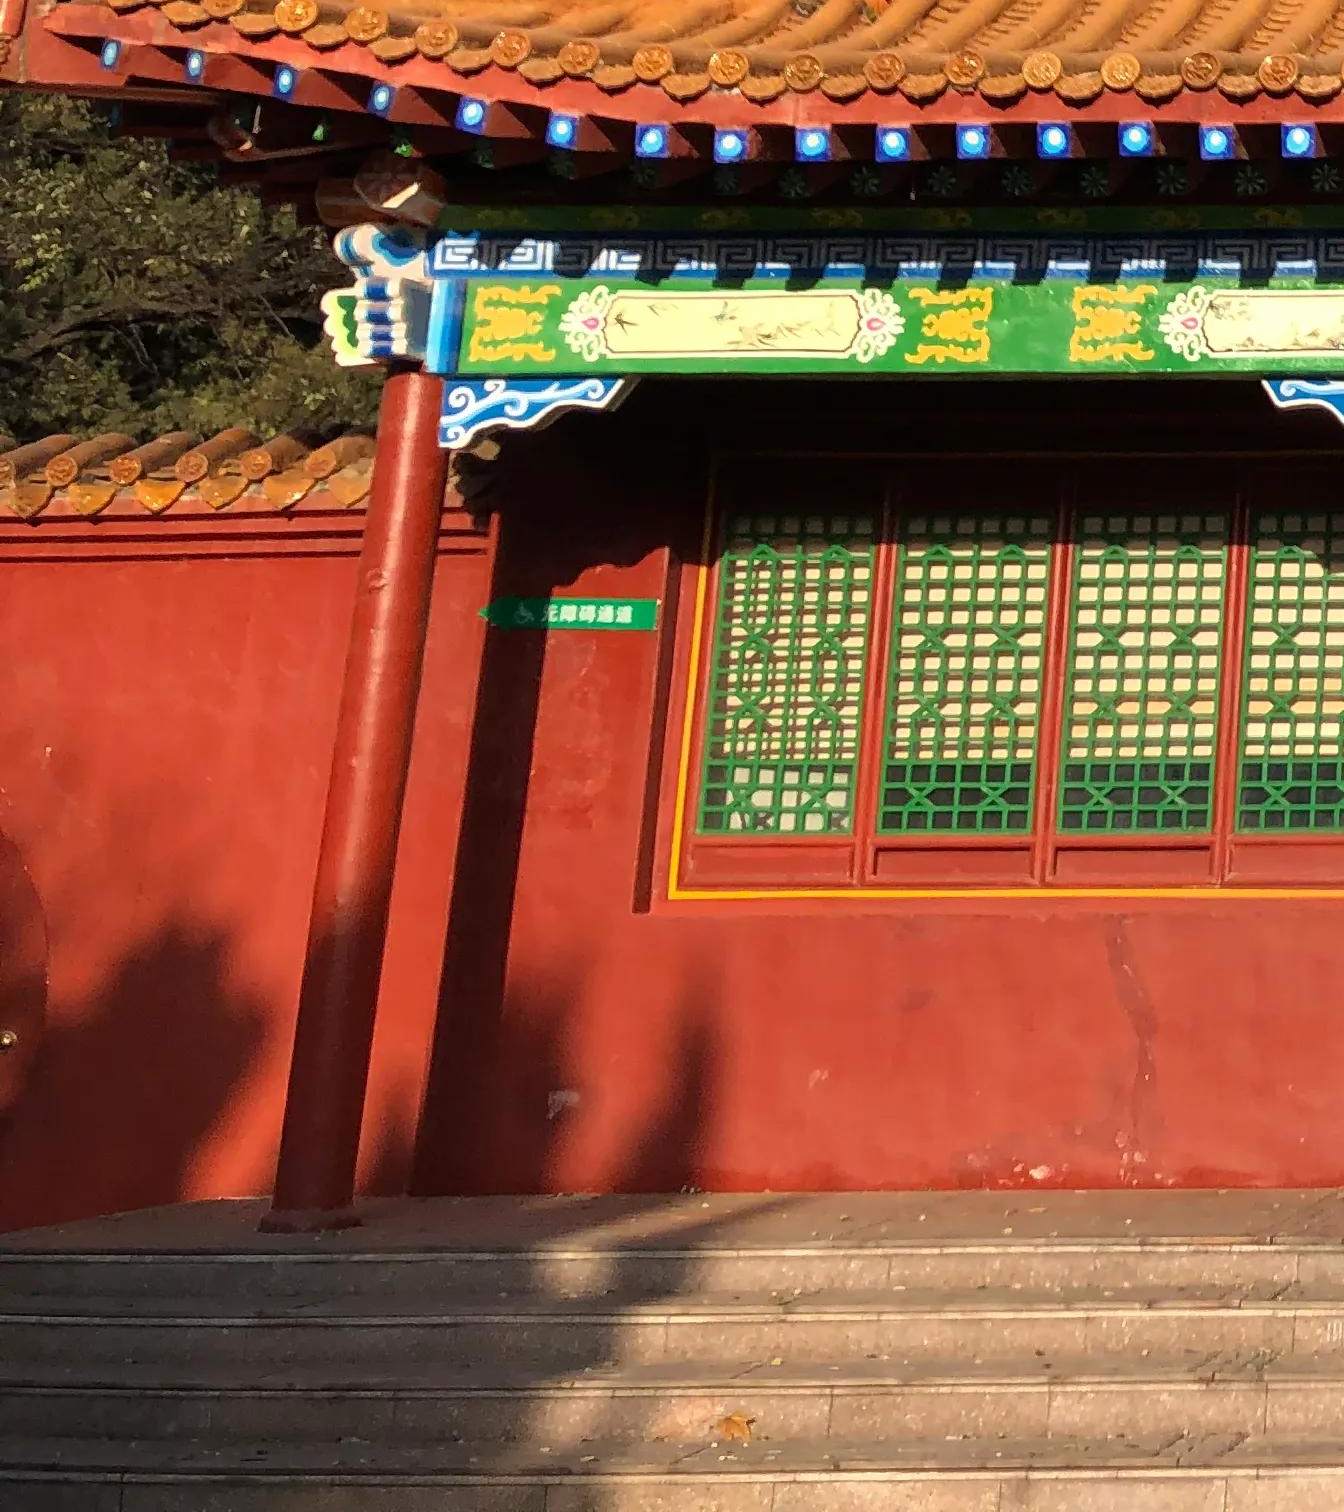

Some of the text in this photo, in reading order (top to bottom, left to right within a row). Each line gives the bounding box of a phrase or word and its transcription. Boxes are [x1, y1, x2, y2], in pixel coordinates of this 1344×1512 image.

[541, 604, 633, 624] 无障碍通道
